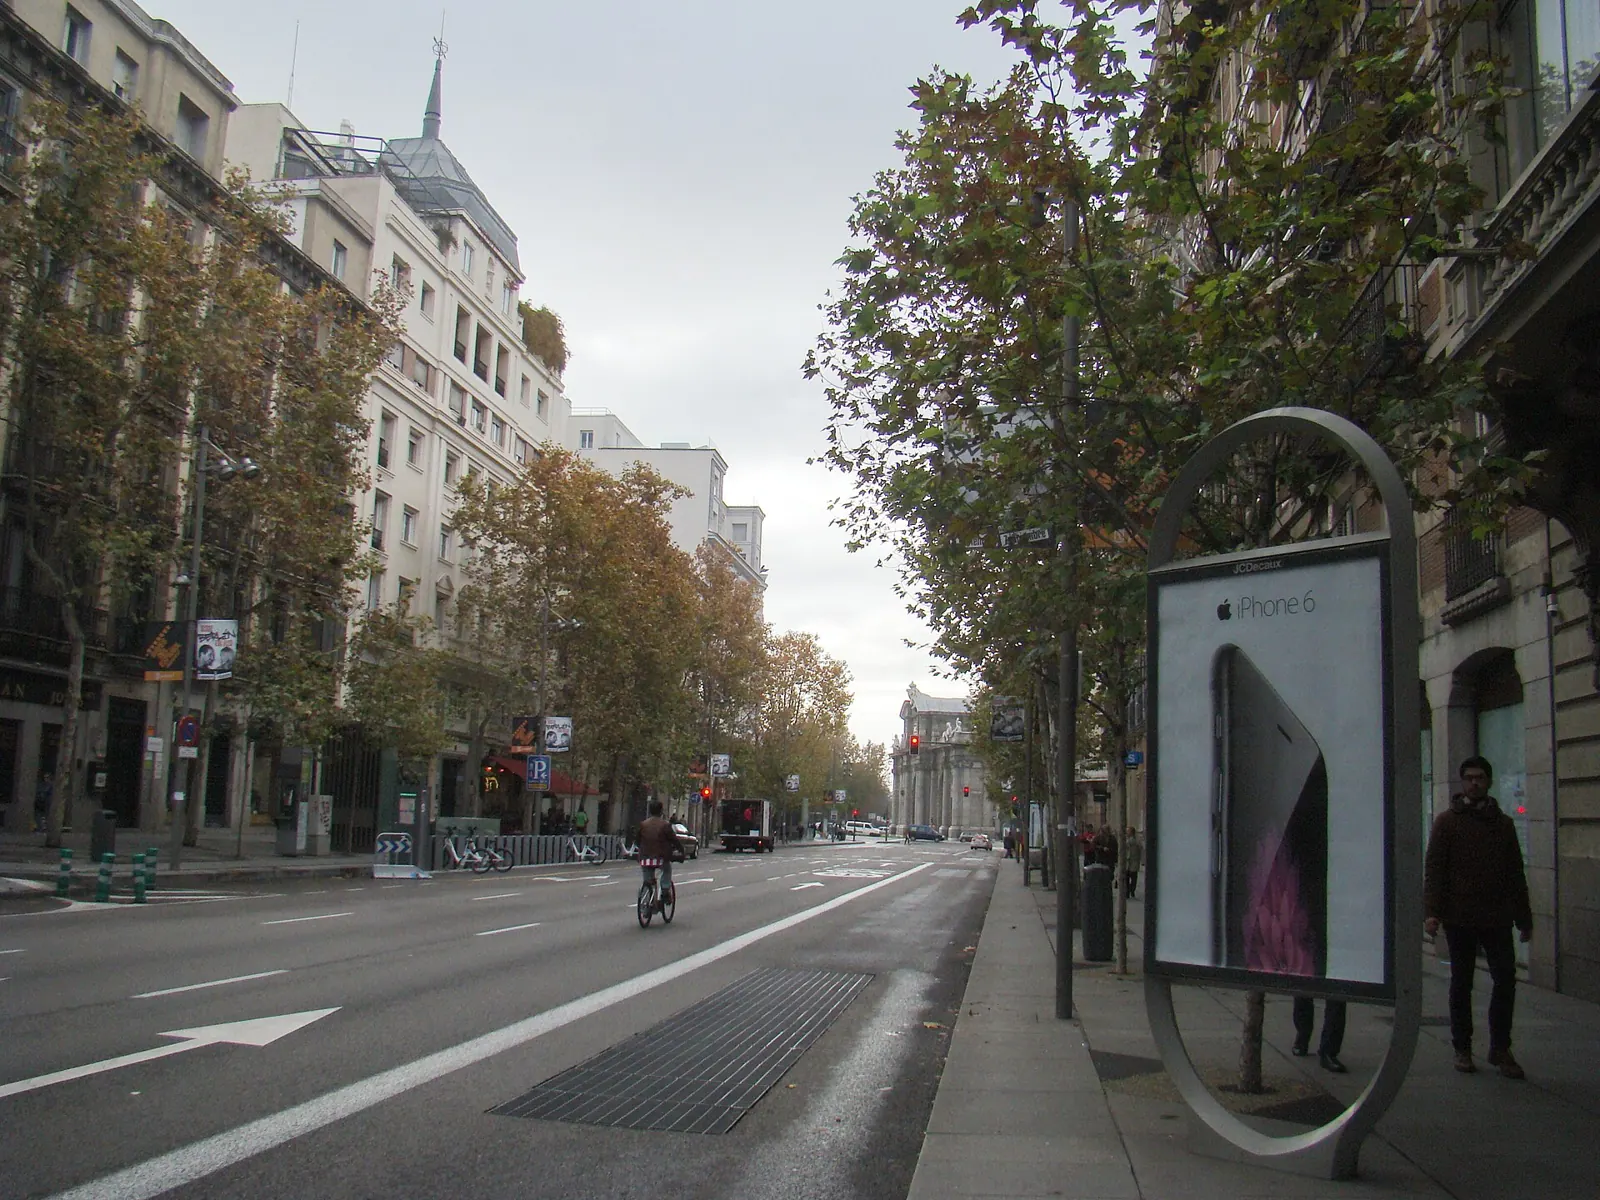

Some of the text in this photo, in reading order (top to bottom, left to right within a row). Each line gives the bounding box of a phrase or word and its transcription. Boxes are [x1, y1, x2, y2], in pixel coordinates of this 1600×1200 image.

[1232, 560, 1282, 574] JCDecaux
[1237, 589, 1316, 619] iPhone 6
[533, 760, 547, 780] P
